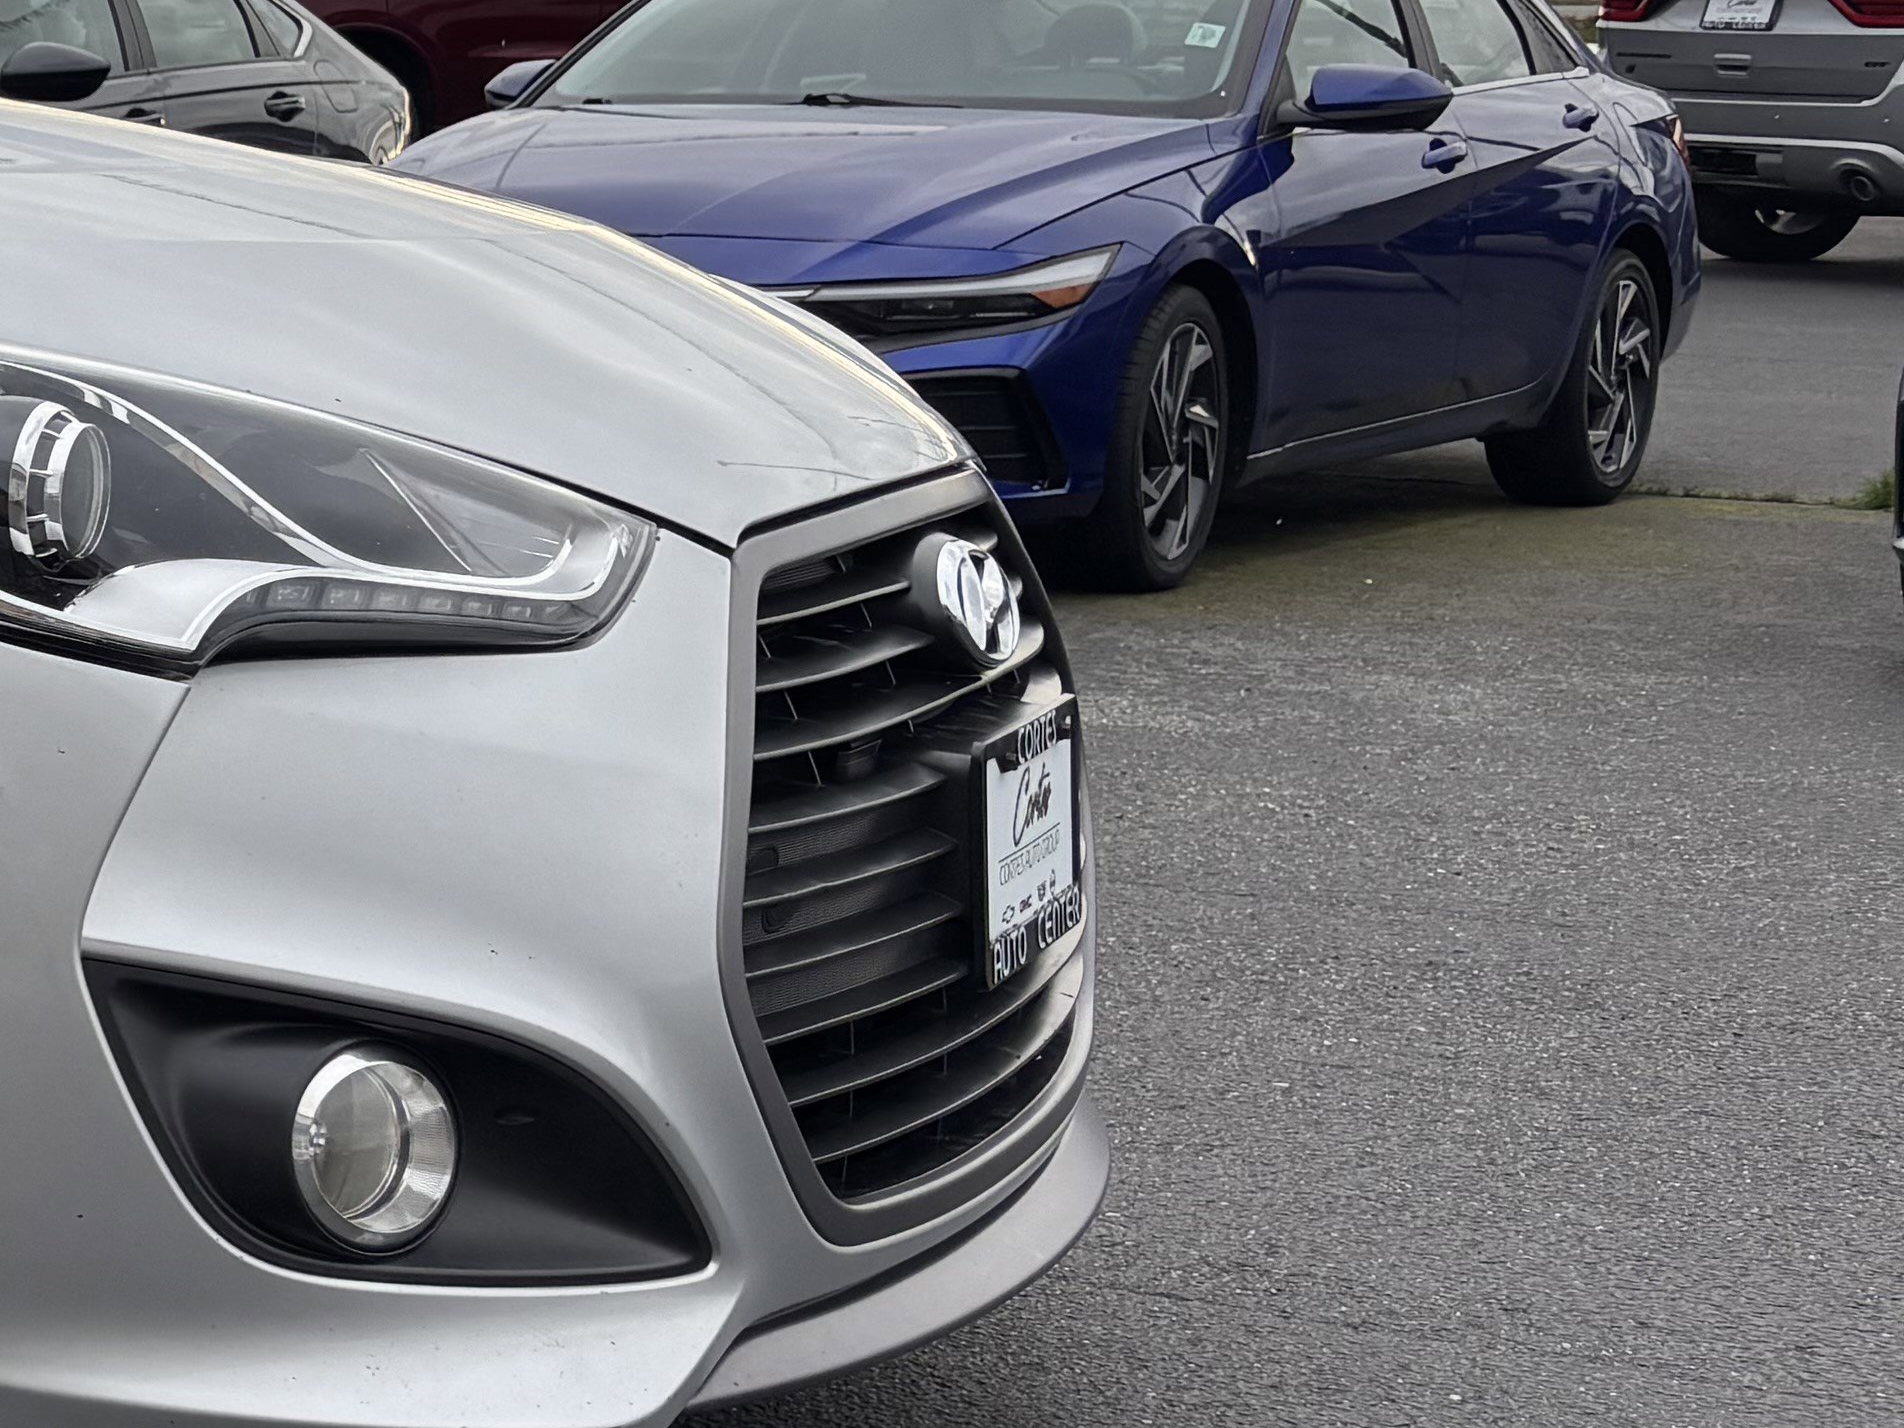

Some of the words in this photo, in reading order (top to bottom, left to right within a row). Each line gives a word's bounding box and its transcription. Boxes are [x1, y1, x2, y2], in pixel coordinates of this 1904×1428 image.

[1017, 709, 1057, 765] CORTES
[993, 925, 1028, 985] AUTO
[1037, 884, 1081, 949] CENTER
